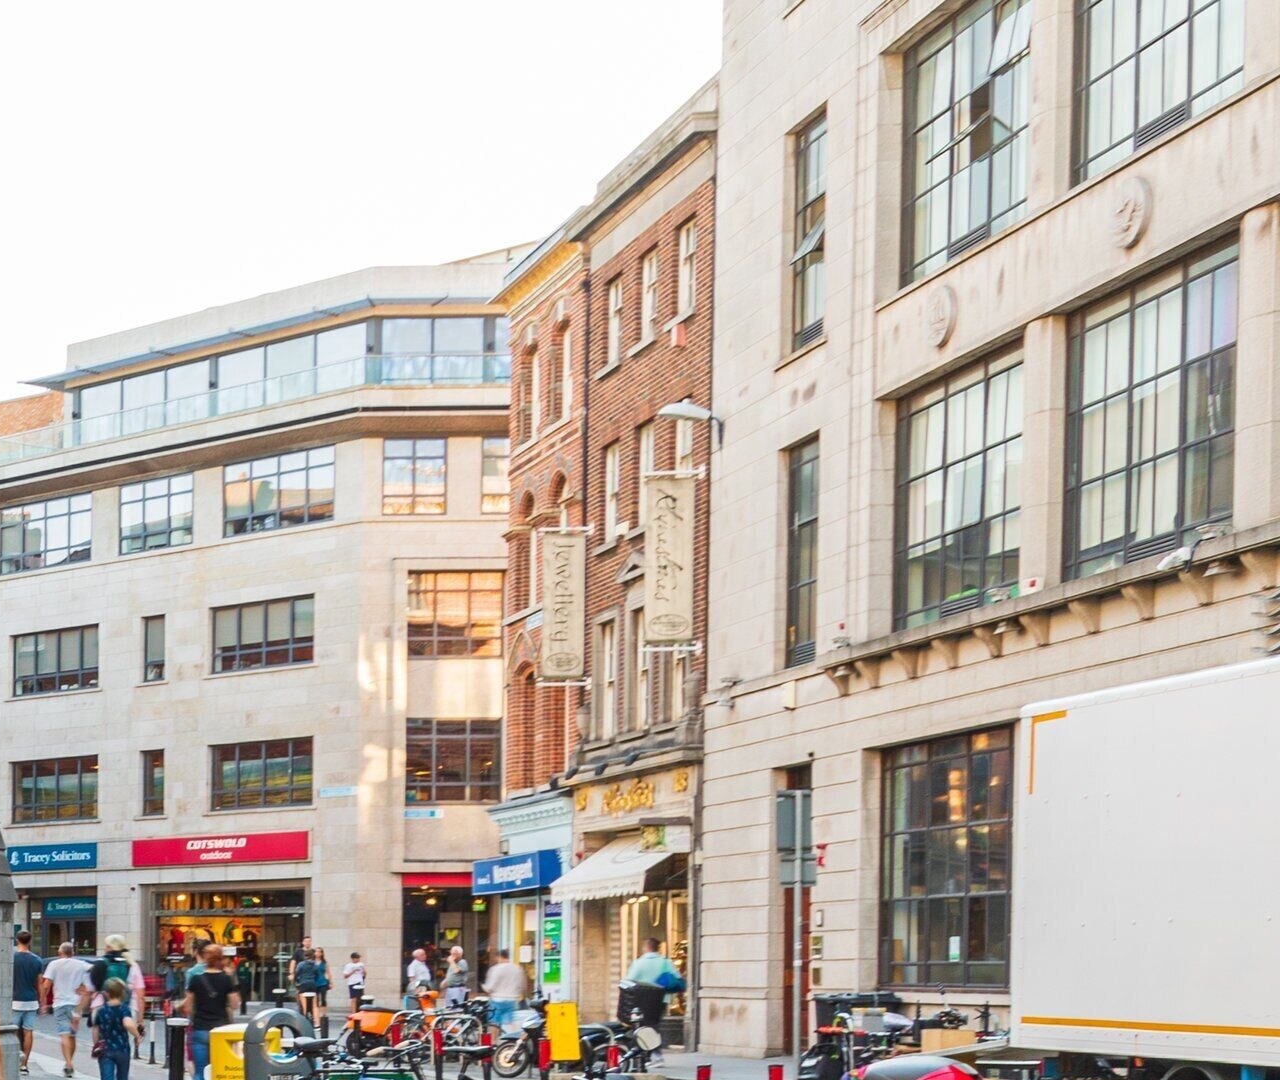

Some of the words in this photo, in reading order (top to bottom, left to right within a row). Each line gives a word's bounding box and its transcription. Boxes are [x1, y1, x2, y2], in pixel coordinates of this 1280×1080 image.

[549, 541, 576, 642] Jewellery
[186, 837, 247, 850] COTSWOLD
[23, 852, 50, 865] Tracey
[51, 850, 91, 862] Solicitors
[200, 850, 233, 860] outdoor
